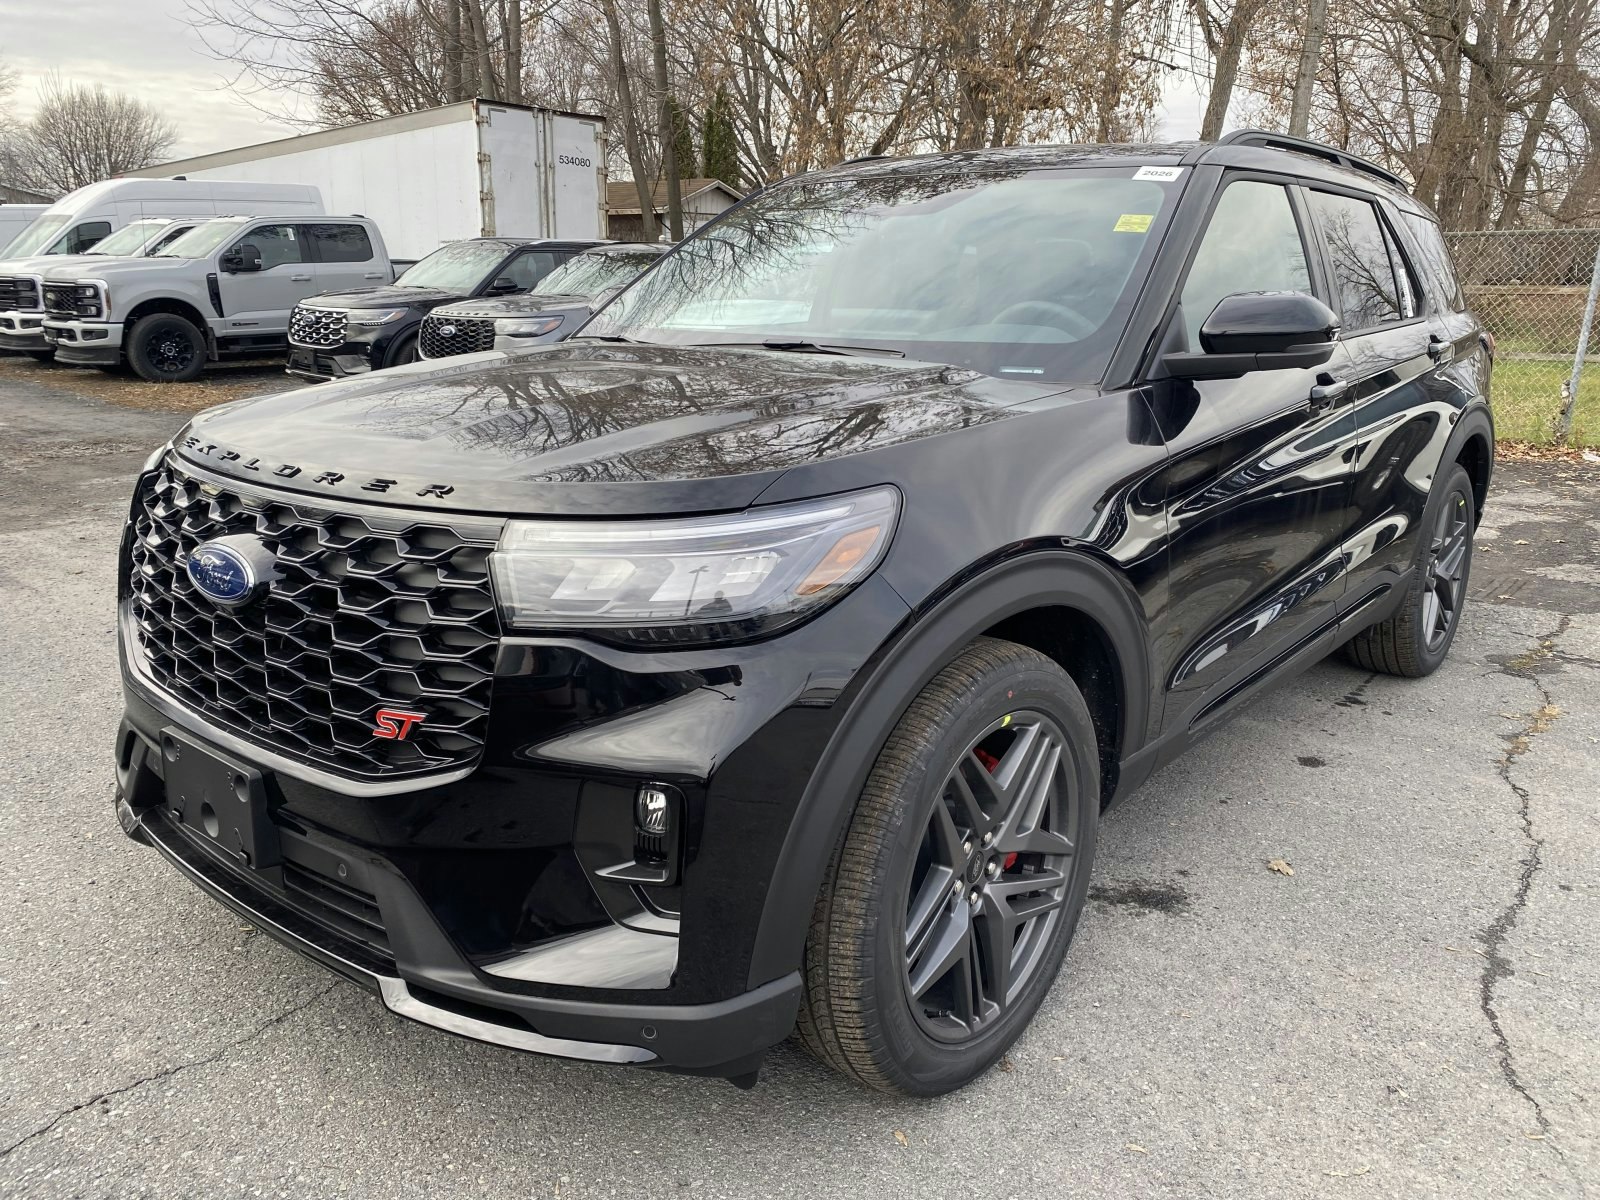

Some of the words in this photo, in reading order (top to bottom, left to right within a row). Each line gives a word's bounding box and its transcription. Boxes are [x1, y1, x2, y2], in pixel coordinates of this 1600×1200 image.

[559, 155, 590, 167] 534080
[182, 436, 455, 499] EXPLORER
[196, 554, 234, 593] Ford
[372, 709, 427, 740] ST
